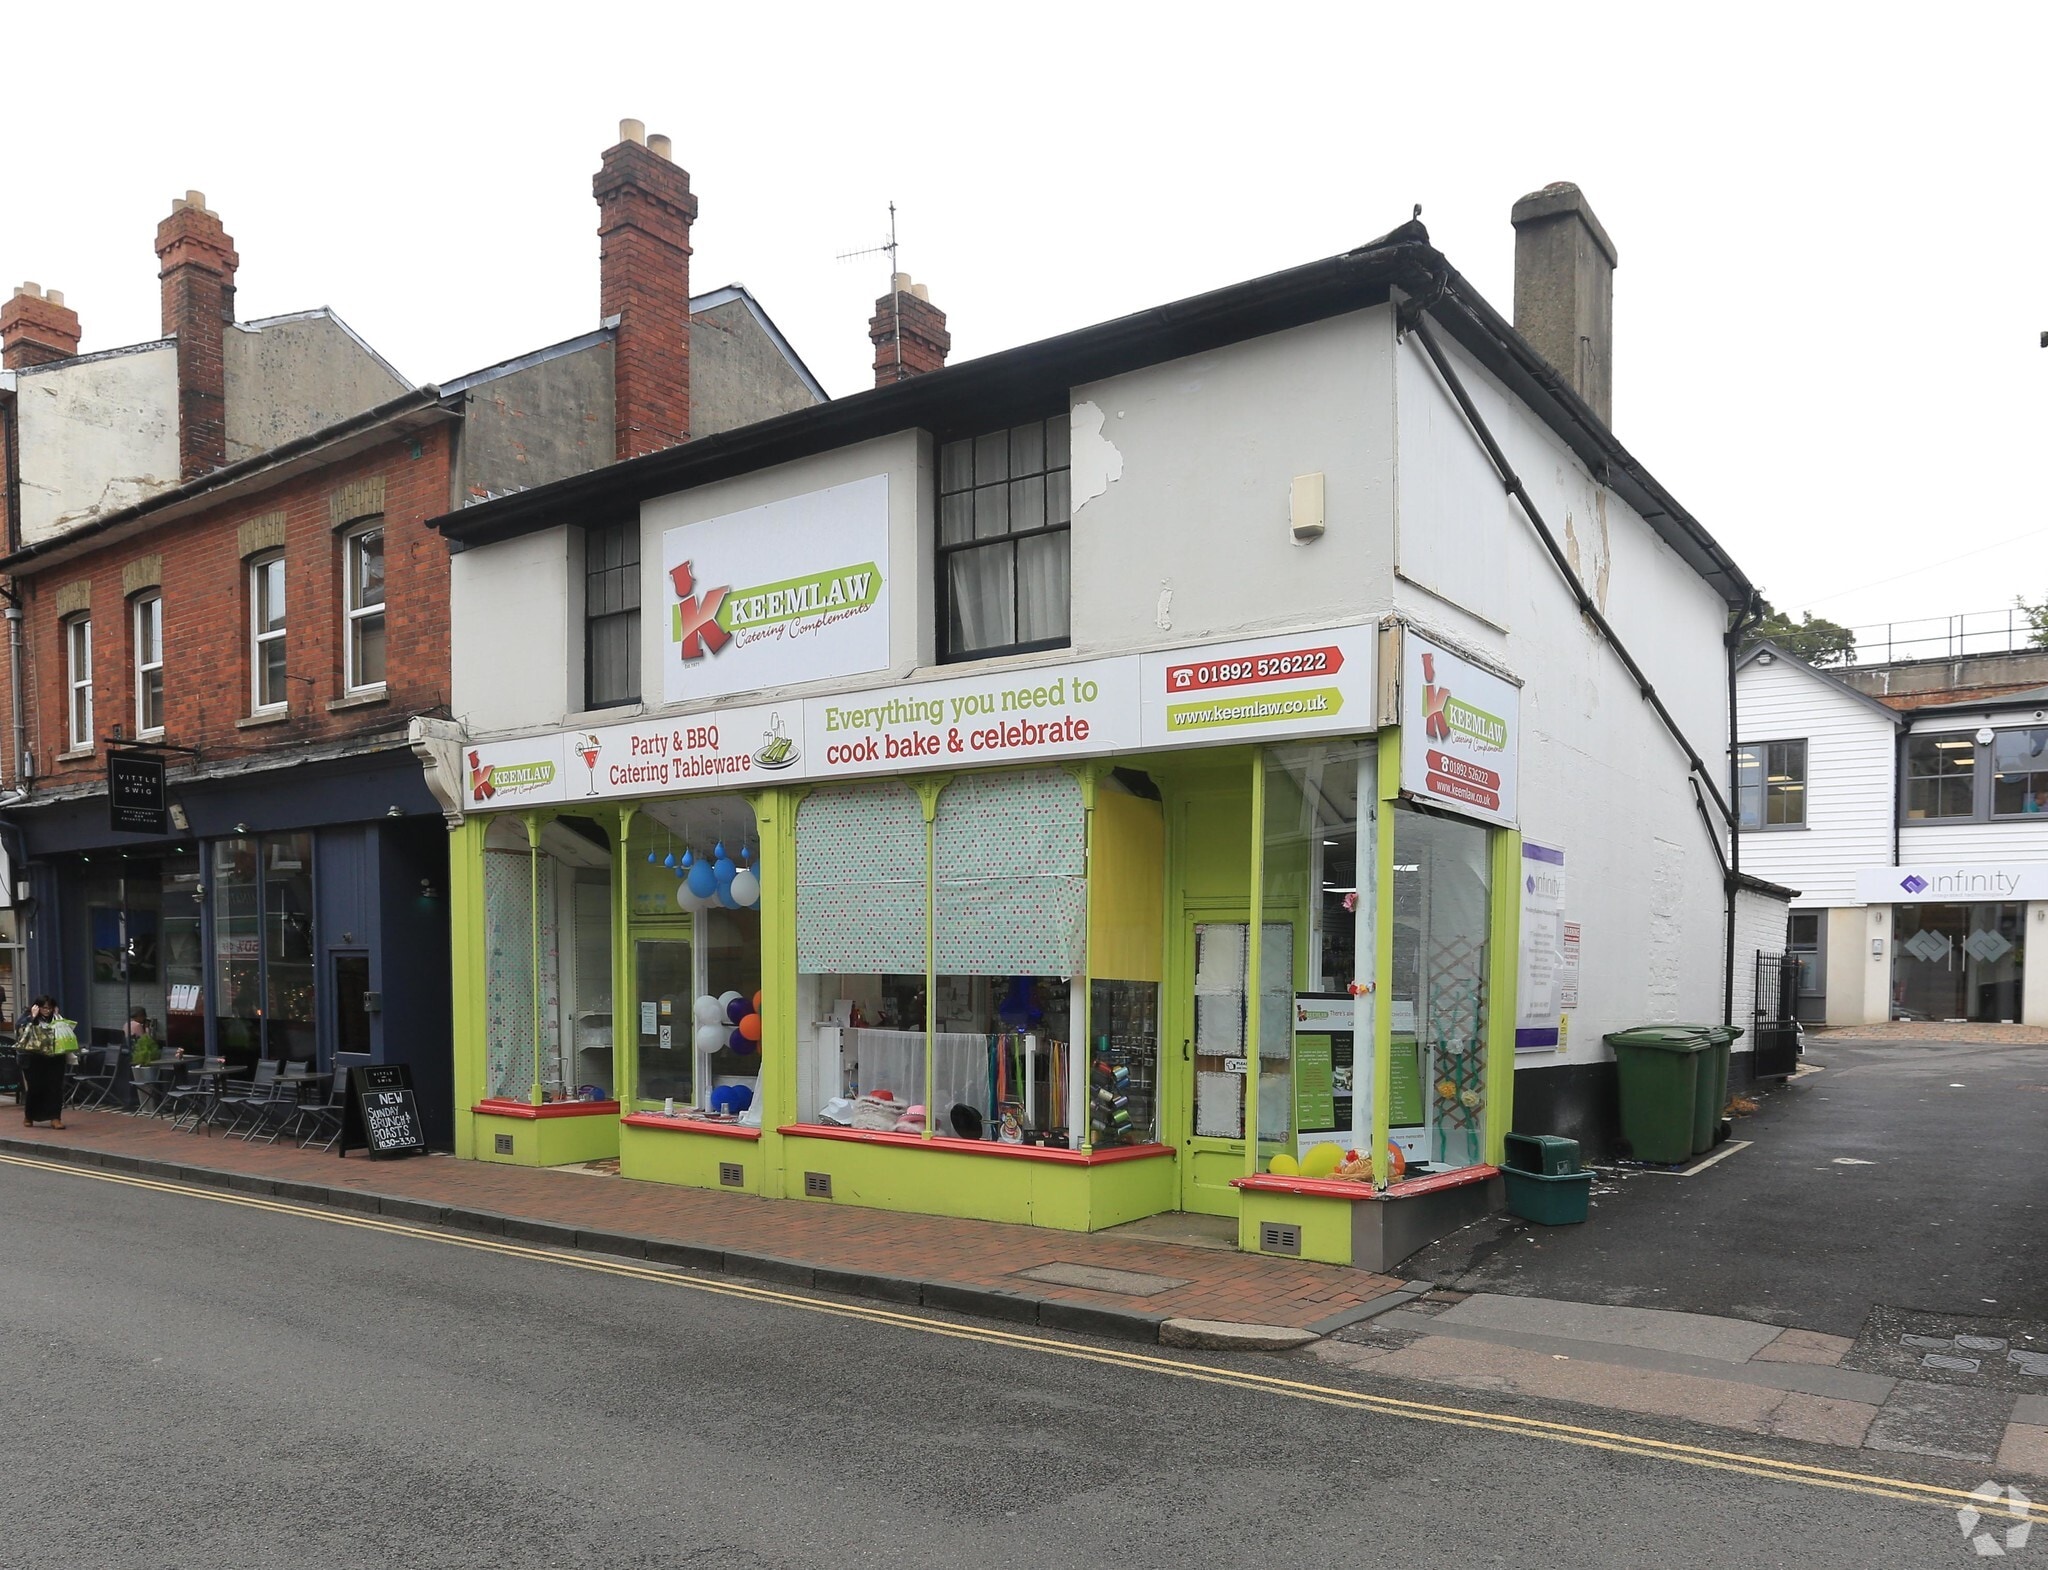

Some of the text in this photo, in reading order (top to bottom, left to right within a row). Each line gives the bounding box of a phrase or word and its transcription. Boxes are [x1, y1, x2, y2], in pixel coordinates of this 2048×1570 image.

[729, 572, 873, 626] KEEMLAW
[735, 603, 871, 649] Catering Complements
[1198, 652, 1326, 684] 01892 526222
[825, 676, 1098, 732] Everything you need to
[1173, 694, 1328, 726] www.keemlaw.co.uk
[1449, 704, 1504, 743] KEEMLAW
[631, 725, 719, 758] Party & BBQ
[826, 715, 1090, 765] cook bake & celebrate
[1451, 728, 1472, 748] Catering
[118, 774, 157, 783] VITTLE
[494, 765, 551, 785] KEEMLAW
[609, 754, 750, 785] Catering Tableware
[1449, 760, 1489, 785] 01892 526222
[125, 786, 152, 795] SWIG
[1436, 780, 1491, 806] www.keemlaw.co.uk
[1932, 870, 2021, 896] infinity
[378, 1092, 403, 1105] NEW
[367, 1106, 399, 1119] SUNDAY
[370, 1115, 406, 1129] BRUNCH
[373, 1125, 410, 1142] ROASTS
